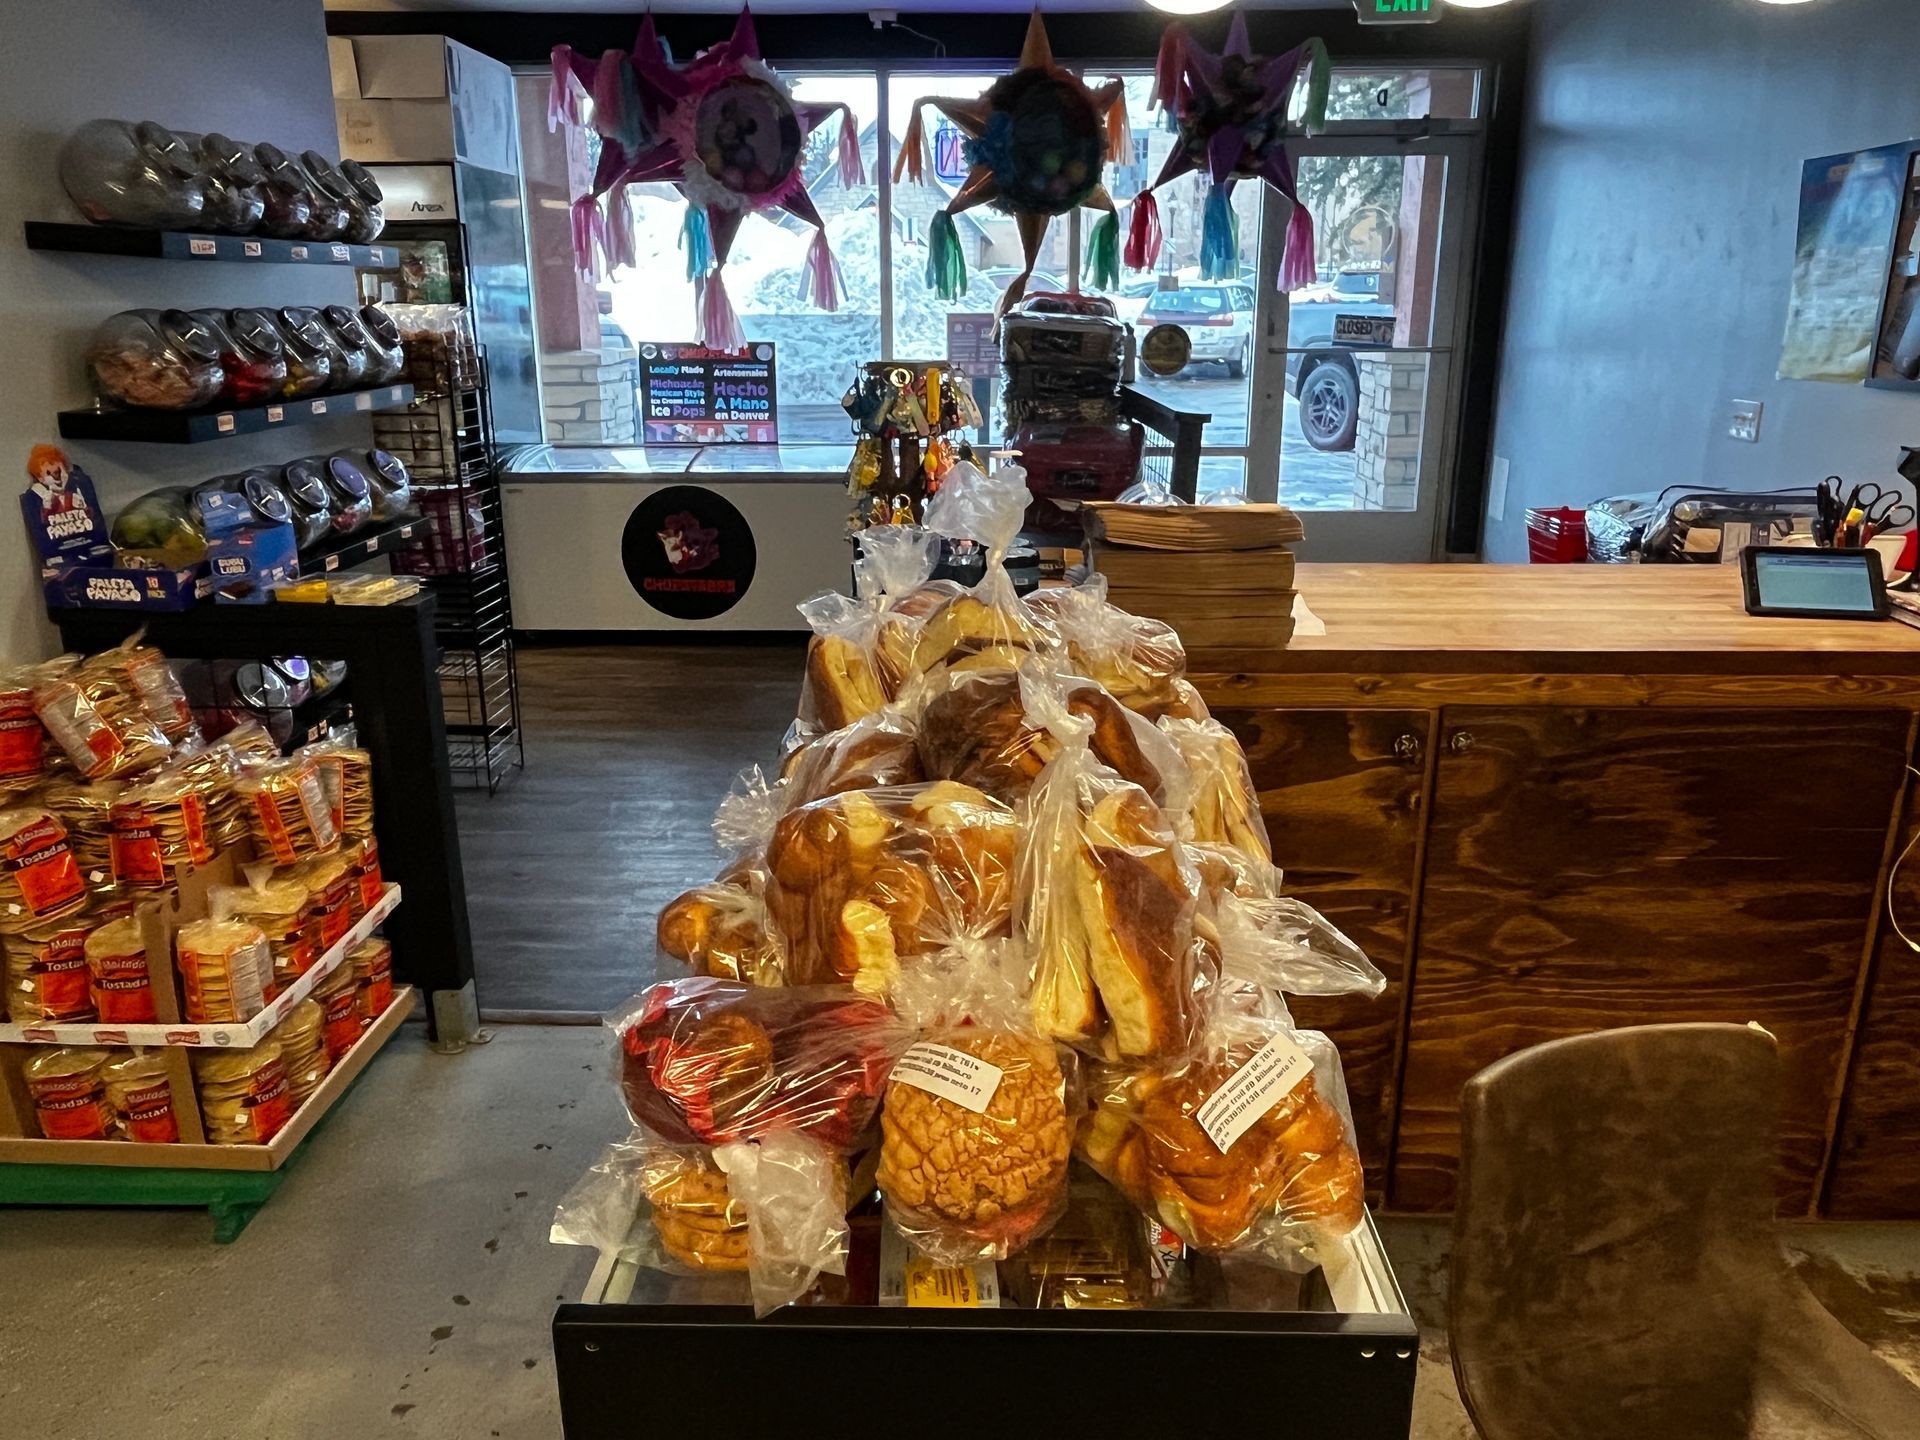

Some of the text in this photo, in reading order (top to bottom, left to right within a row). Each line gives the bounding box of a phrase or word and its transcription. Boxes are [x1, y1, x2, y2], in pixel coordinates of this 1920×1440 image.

[1336, 319, 1373, 335] CLOSED
[649, 365, 679, 375] Locally
[681, 365, 704, 374] Made
[684, 390, 705, 398] Style
[713, 382, 769, 397] Hecho
[715, 398, 769, 410] A Mano
[651, 405, 706, 418] Ice Pops
[715, 411, 770, 420] en Denver
[48, 510, 87, 526] PALETA
[46, 518, 94, 540] PAYASO
[88, 577, 135, 590] PALETA
[86, 587, 142, 602] PAYASO
[47, 960, 85, 972] Tosta
[1288, 1055, 1297, 1066] 17
[970, 1085, 982, 1096] 17
[130, 1106, 168, 1121] Tostad
